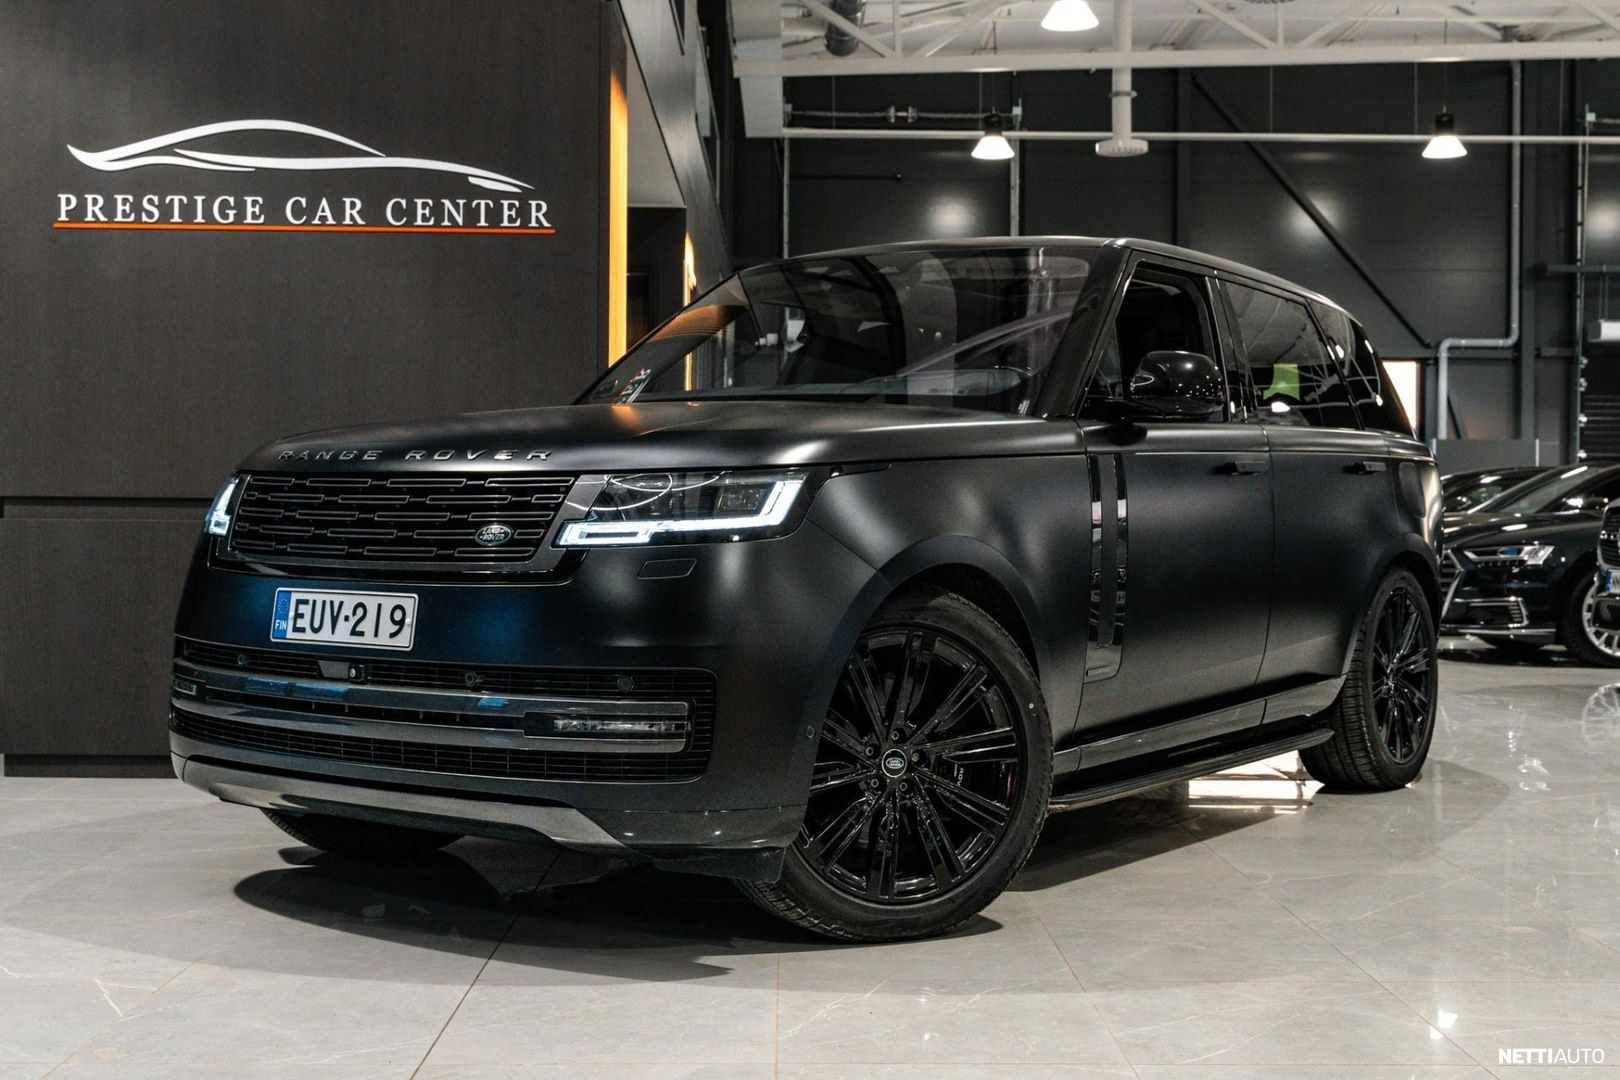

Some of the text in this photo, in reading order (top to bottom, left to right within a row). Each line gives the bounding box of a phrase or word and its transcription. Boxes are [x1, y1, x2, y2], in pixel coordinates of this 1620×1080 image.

[57, 194, 552, 227] PRESTIGE CAR CENTER
[278, 449, 552, 461] RANGE ROVER
[275, 619, 287, 630] FIN
[292, 598, 407, 639] EUV-219
